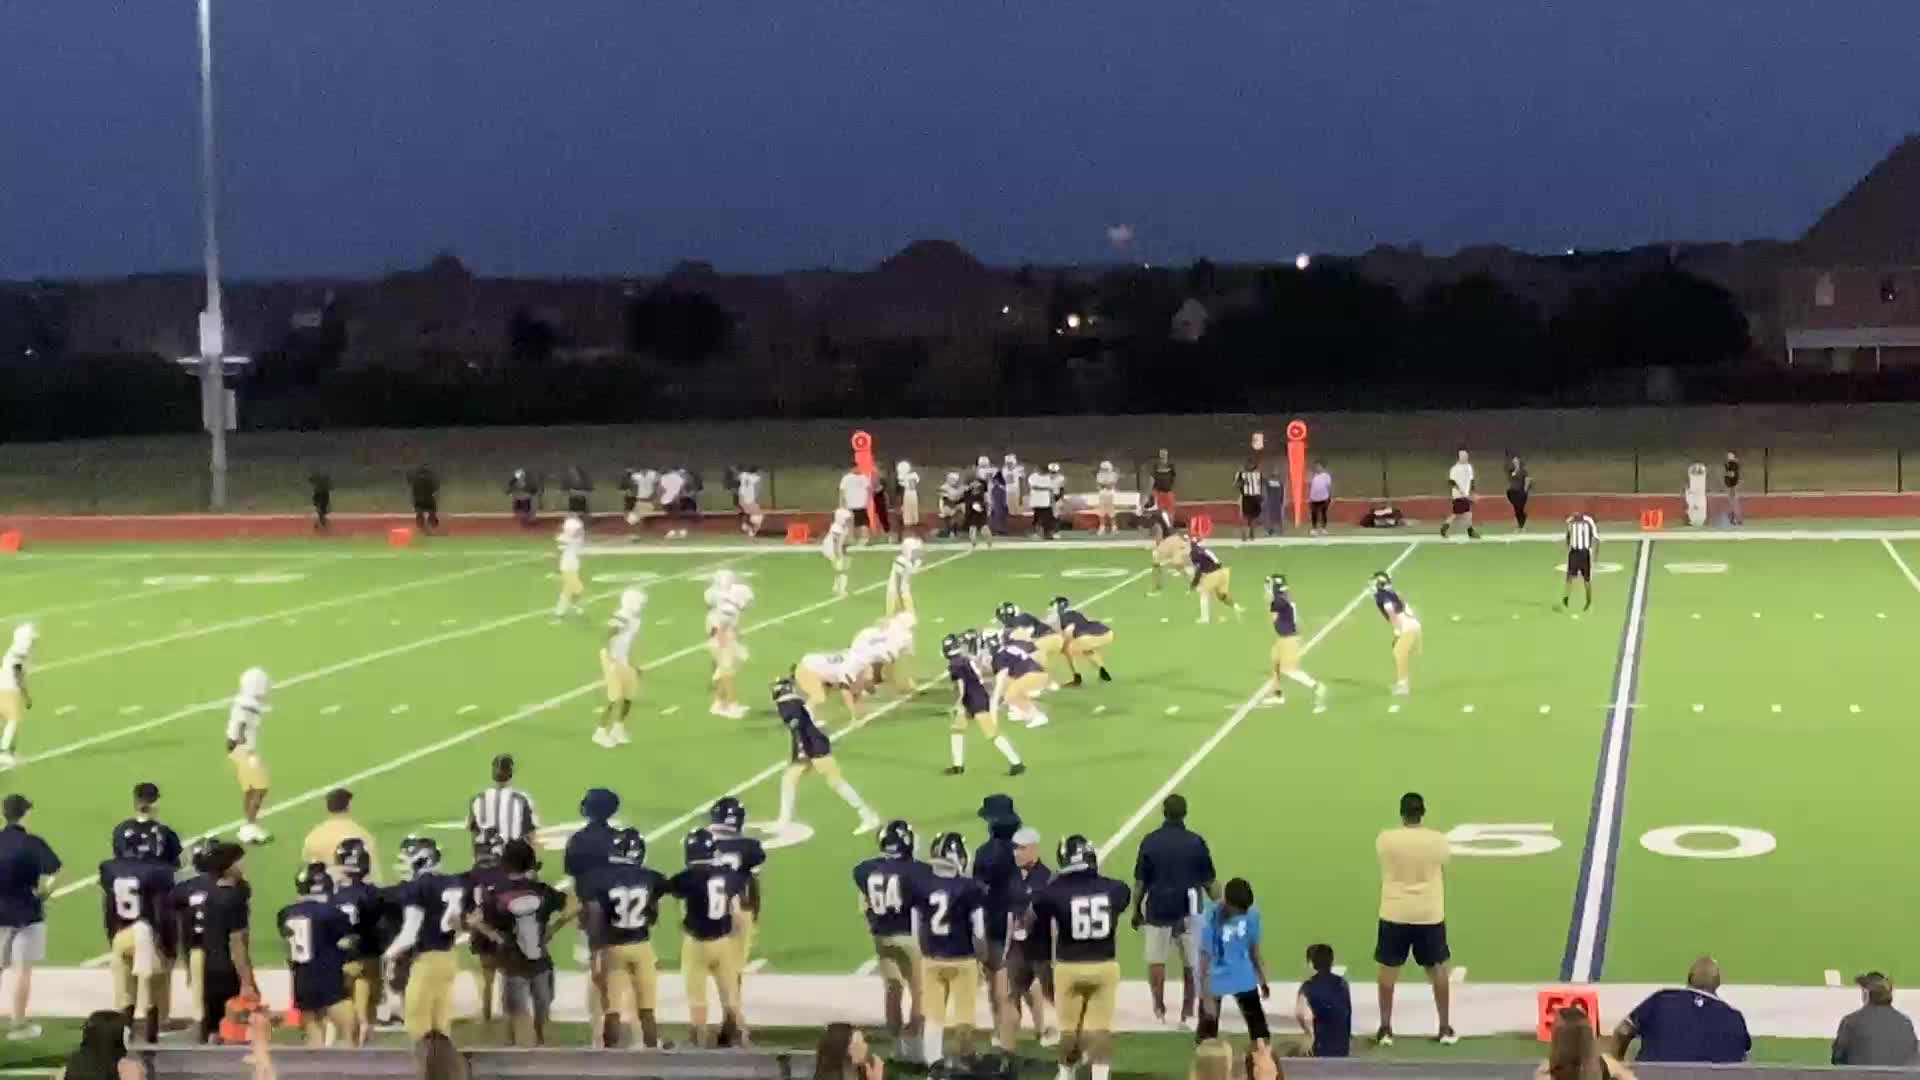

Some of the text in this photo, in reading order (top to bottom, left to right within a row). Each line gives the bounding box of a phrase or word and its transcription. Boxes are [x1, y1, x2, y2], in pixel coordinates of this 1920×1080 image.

[608, 886, 649, 929] 32
[707, 877, 727, 920] 6
[867, 873, 903, 916] 64
[929, 891, 950, 936] 2
[1071, 895, 1111, 941] 65
